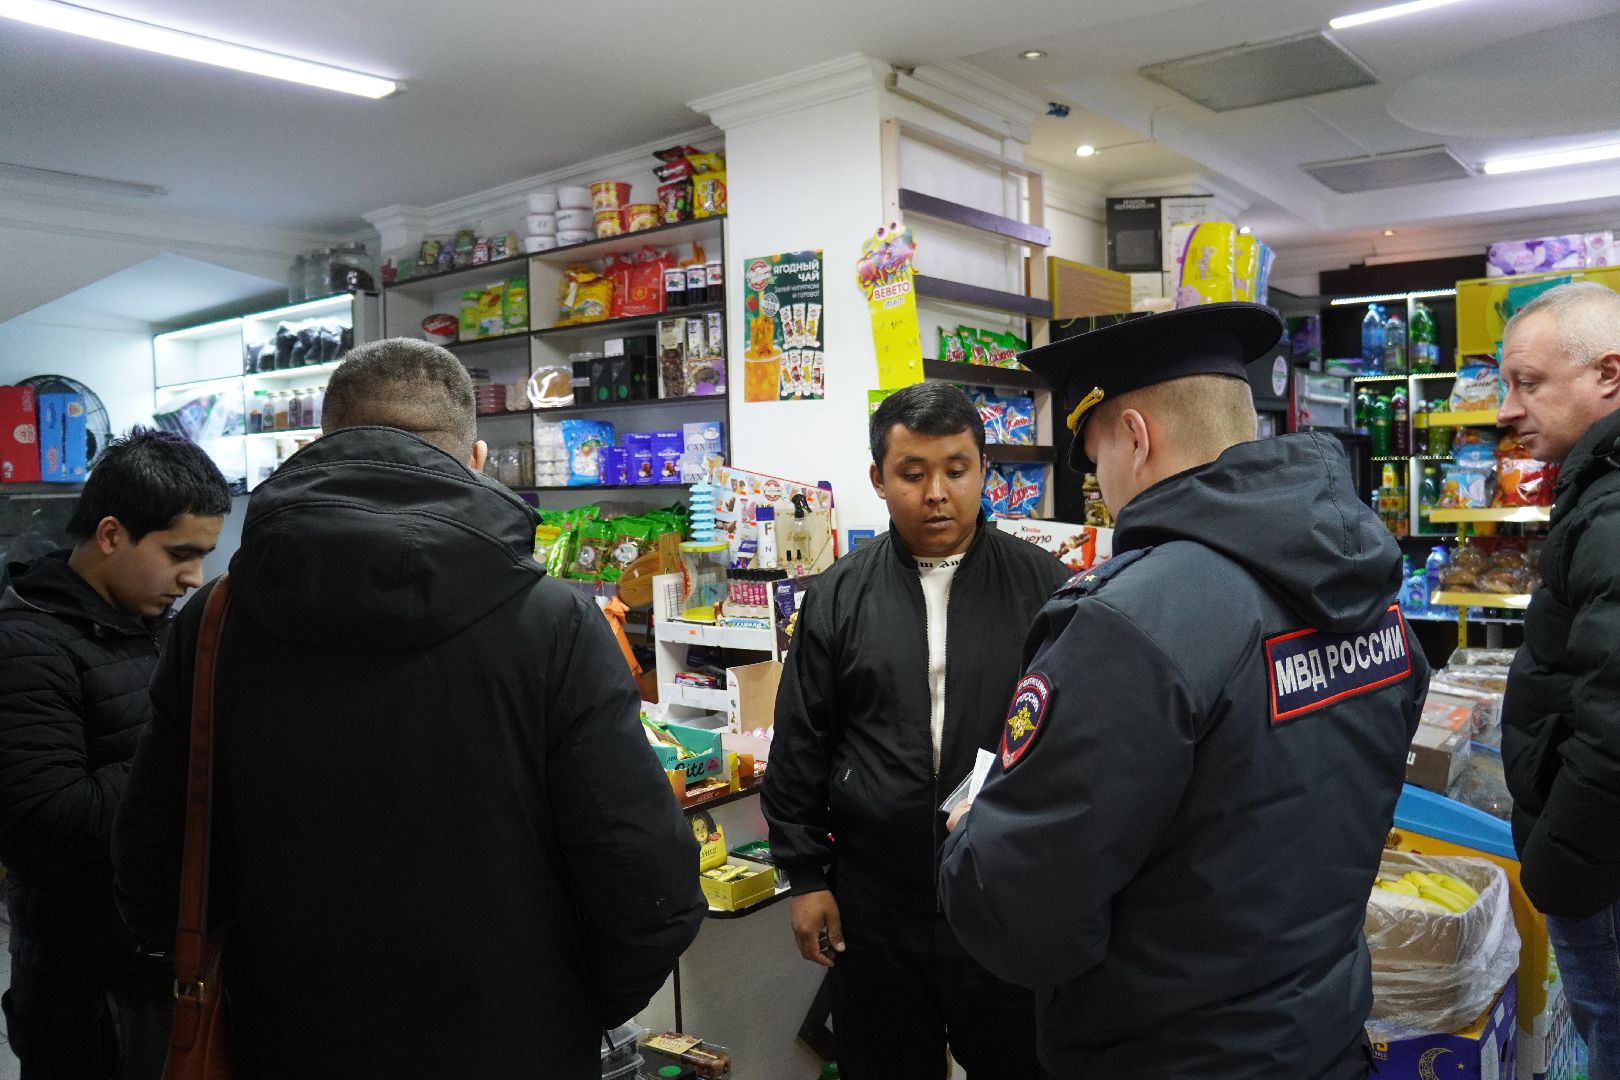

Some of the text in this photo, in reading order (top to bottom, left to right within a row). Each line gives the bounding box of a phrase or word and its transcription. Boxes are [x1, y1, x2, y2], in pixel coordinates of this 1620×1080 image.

[773, 259, 819, 274] ЯГОДНЫЙ
[798, 270, 819, 282] ЧАЙ
[874, 282, 910, 300] BEBETO
[1275, 624, 1406, 696] МВД РОССИИ
